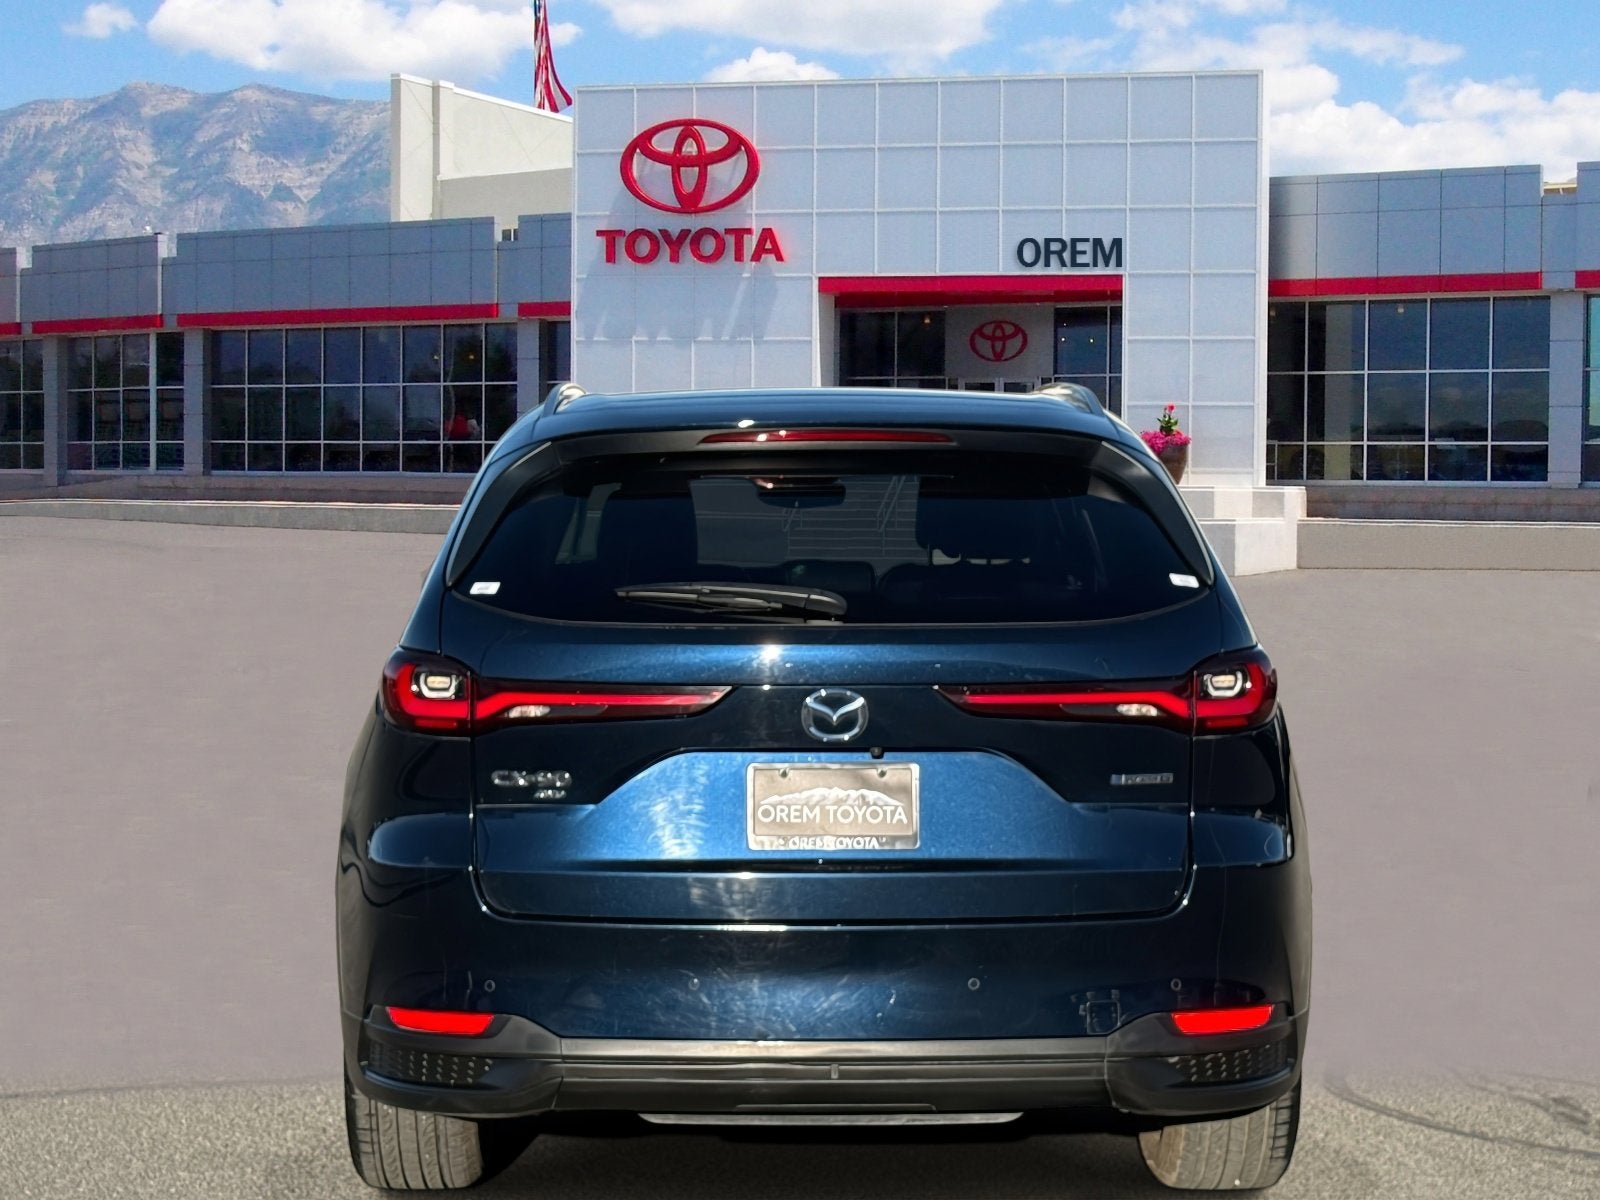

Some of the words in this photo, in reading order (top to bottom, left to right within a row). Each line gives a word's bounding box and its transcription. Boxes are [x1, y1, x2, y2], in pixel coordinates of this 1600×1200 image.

[596, 227, 785, 264] TOYOTA
[1017, 237, 1122, 267] OREM
[757, 804, 820, 824] OREM
[825, 805, 908, 824] TOYOTA
